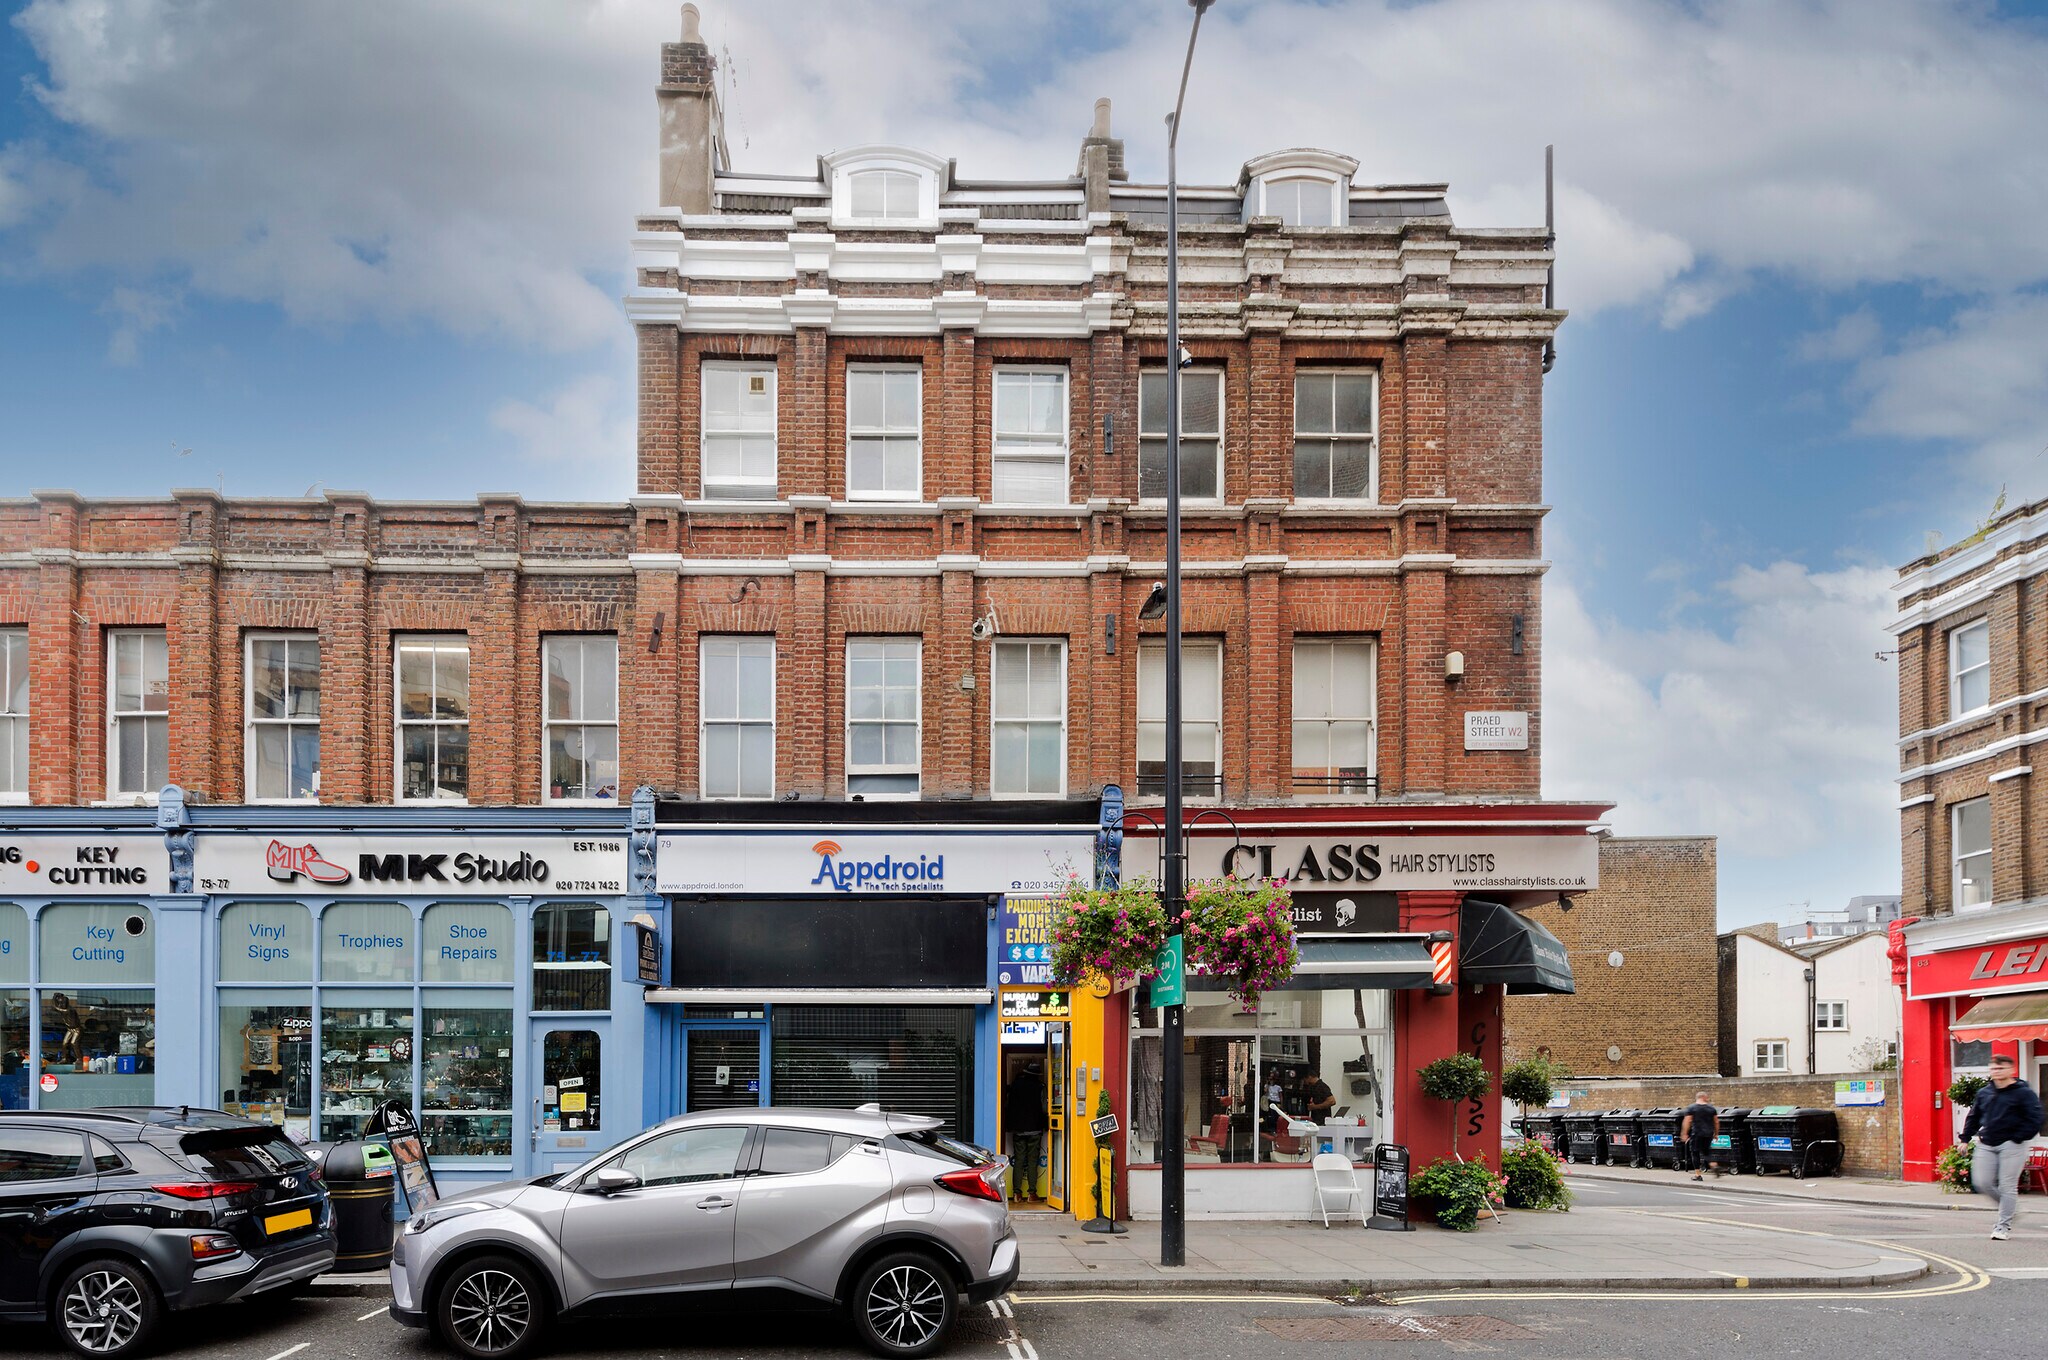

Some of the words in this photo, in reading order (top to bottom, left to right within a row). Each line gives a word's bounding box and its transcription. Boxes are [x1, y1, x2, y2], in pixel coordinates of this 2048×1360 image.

[1471, 716, 1501, 725] PRAED
[1471, 727, 1505, 737] STREET
[1508, 727, 1522, 737] W2
[573, 842, 596, 852] EST.
[598, 842, 620, 852] 1986
[660, 840, 672, 848] 79
[76, 846, 119, 864] KEY
[359, 853, 449, 882] MK
[453, 851, 549, 883] Studio
[1222, 843, 1383, 883] CLASS
[1390, 853, 1425, 873] HAIR
[1428, 853, 1496, 873] STYLISTS
[48, 866, 147, 884] CUTTING
[811, 853, 944, 892] Appdroid
[556, 881, 572, 890] 020
[575, 881, 596, 890] 7724
[598, 881, 620, 890] 7422
[660, 882, 744, 890] www.appdroid.london
[864, 882, 879, 891] The
[881, 882, 899, 891] Tech
[901, 882, 944, 892] Specialists
[1024, 881, 1041, 889] 020
[1452, 876, 1586, 888] www.classhairstylists.co.uk
[1018, 914, 1060, 928] MONE
[87, 925, 115, 942] Key
[249, 923, 285, 941] Vinyl
[450, 924, 488, 938] Shoe
[339, 934, 404, 951] Trophies
[72, 946, 125, 964] Cutting
[248, 944, 290, 962] Signs
[441, 946, 497, 962] Repairs
[581, 951, 600, 963] 77
[1001, 974, 1010, 982] 79
[1094, 982, 1109, 992] Yale
[1003, 992, 1040, 1002] BUREAU
[1015, 1000, 1029, 1009] DE
[1002, 1007, 1040, 1016] CHANGE
[563, 1079, 579, 1087] OPEN
